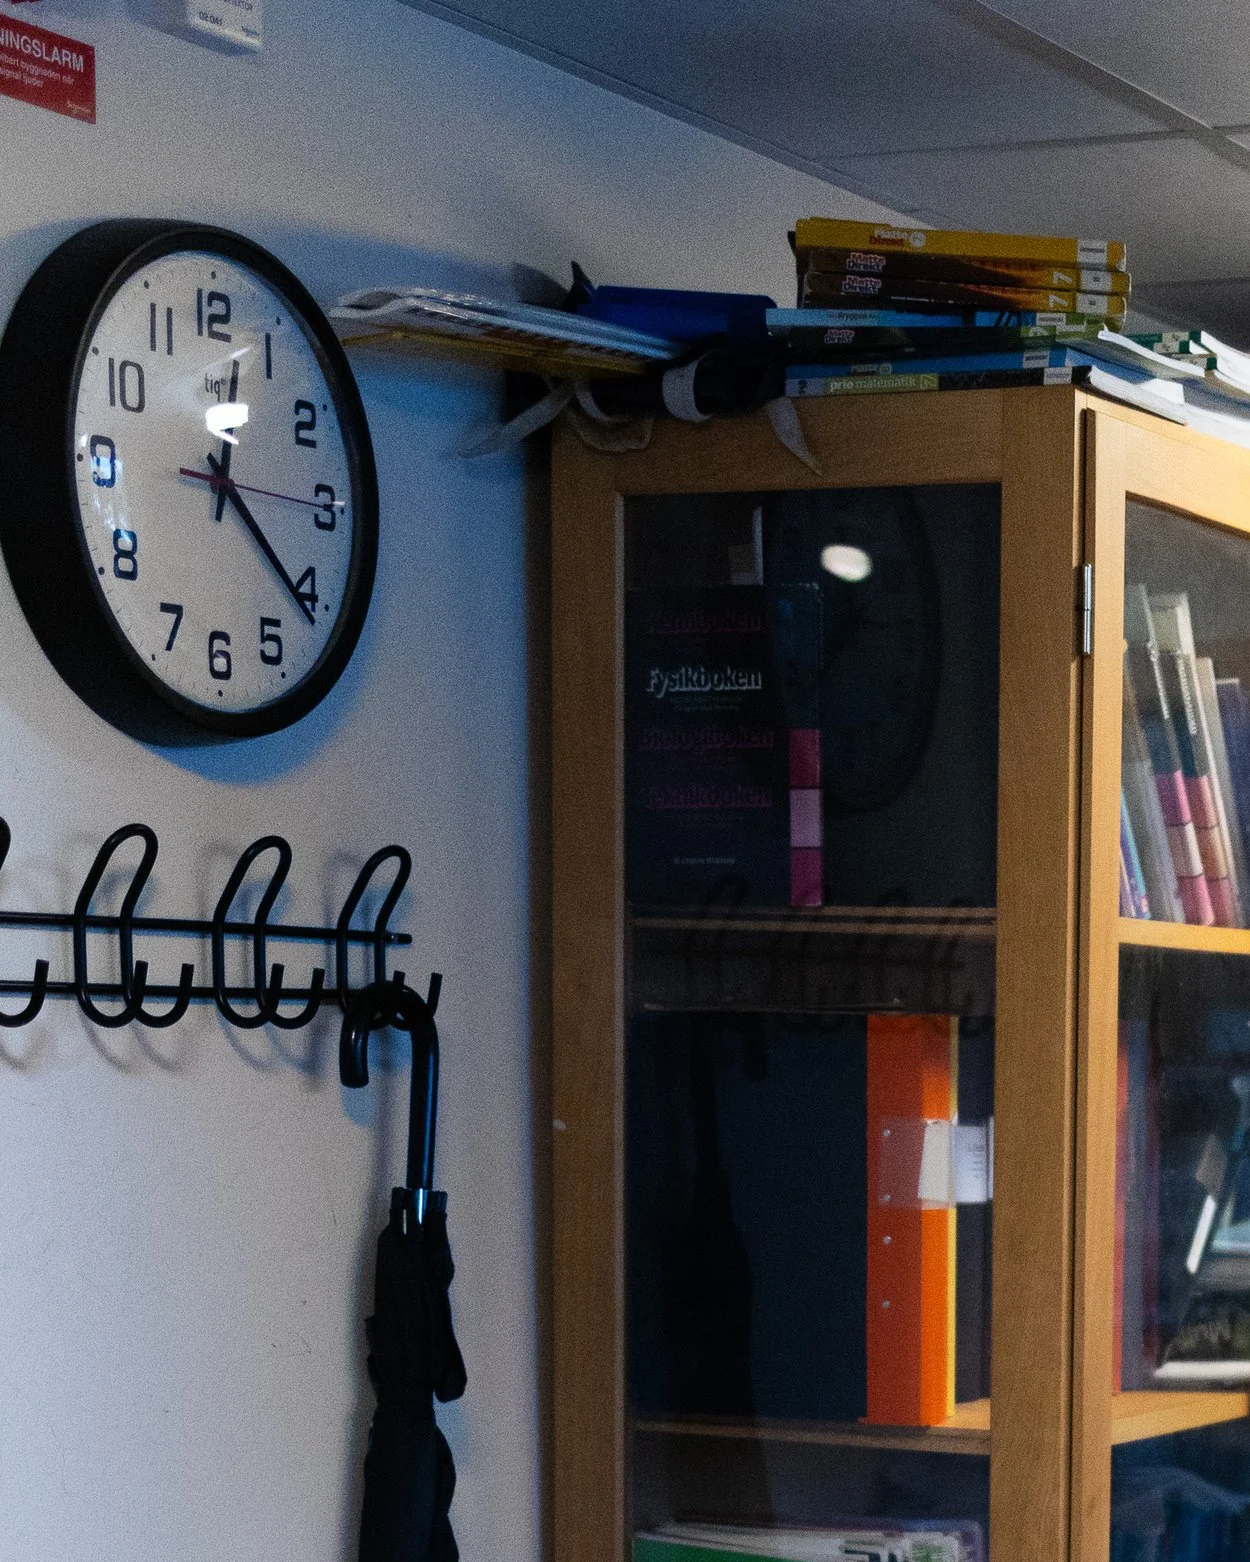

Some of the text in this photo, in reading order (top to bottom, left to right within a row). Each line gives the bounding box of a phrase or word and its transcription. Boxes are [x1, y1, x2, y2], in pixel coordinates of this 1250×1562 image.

[846, 259, 883, 272] Direkt
[846, 275, 882, 288] Matte
[850, 252, 886, 266] Matte
[842, 281, 878, 294] Direkt
[150, 302, 173, 356] 11
[196, 287, 232, 343] 12
[265, 332, 273, 380] 1
[108, 358, 145, 413] 10
[830, 380, 854, 393] prio
[855, 376, 917, 389] matematik
[294, 399, 317, 448] 2
[90, 435, 116, 489] 9
[314, 483, 336, 532] 3
[113, 528, 138, 581] 8
[295, 567, 319, 612] 4
[160, 602, 184, 651] 7
[260, 617, 283, 666] 5
[208, 630, 232, 680] 6
[645, 666, 763, 699] Fysikboken
